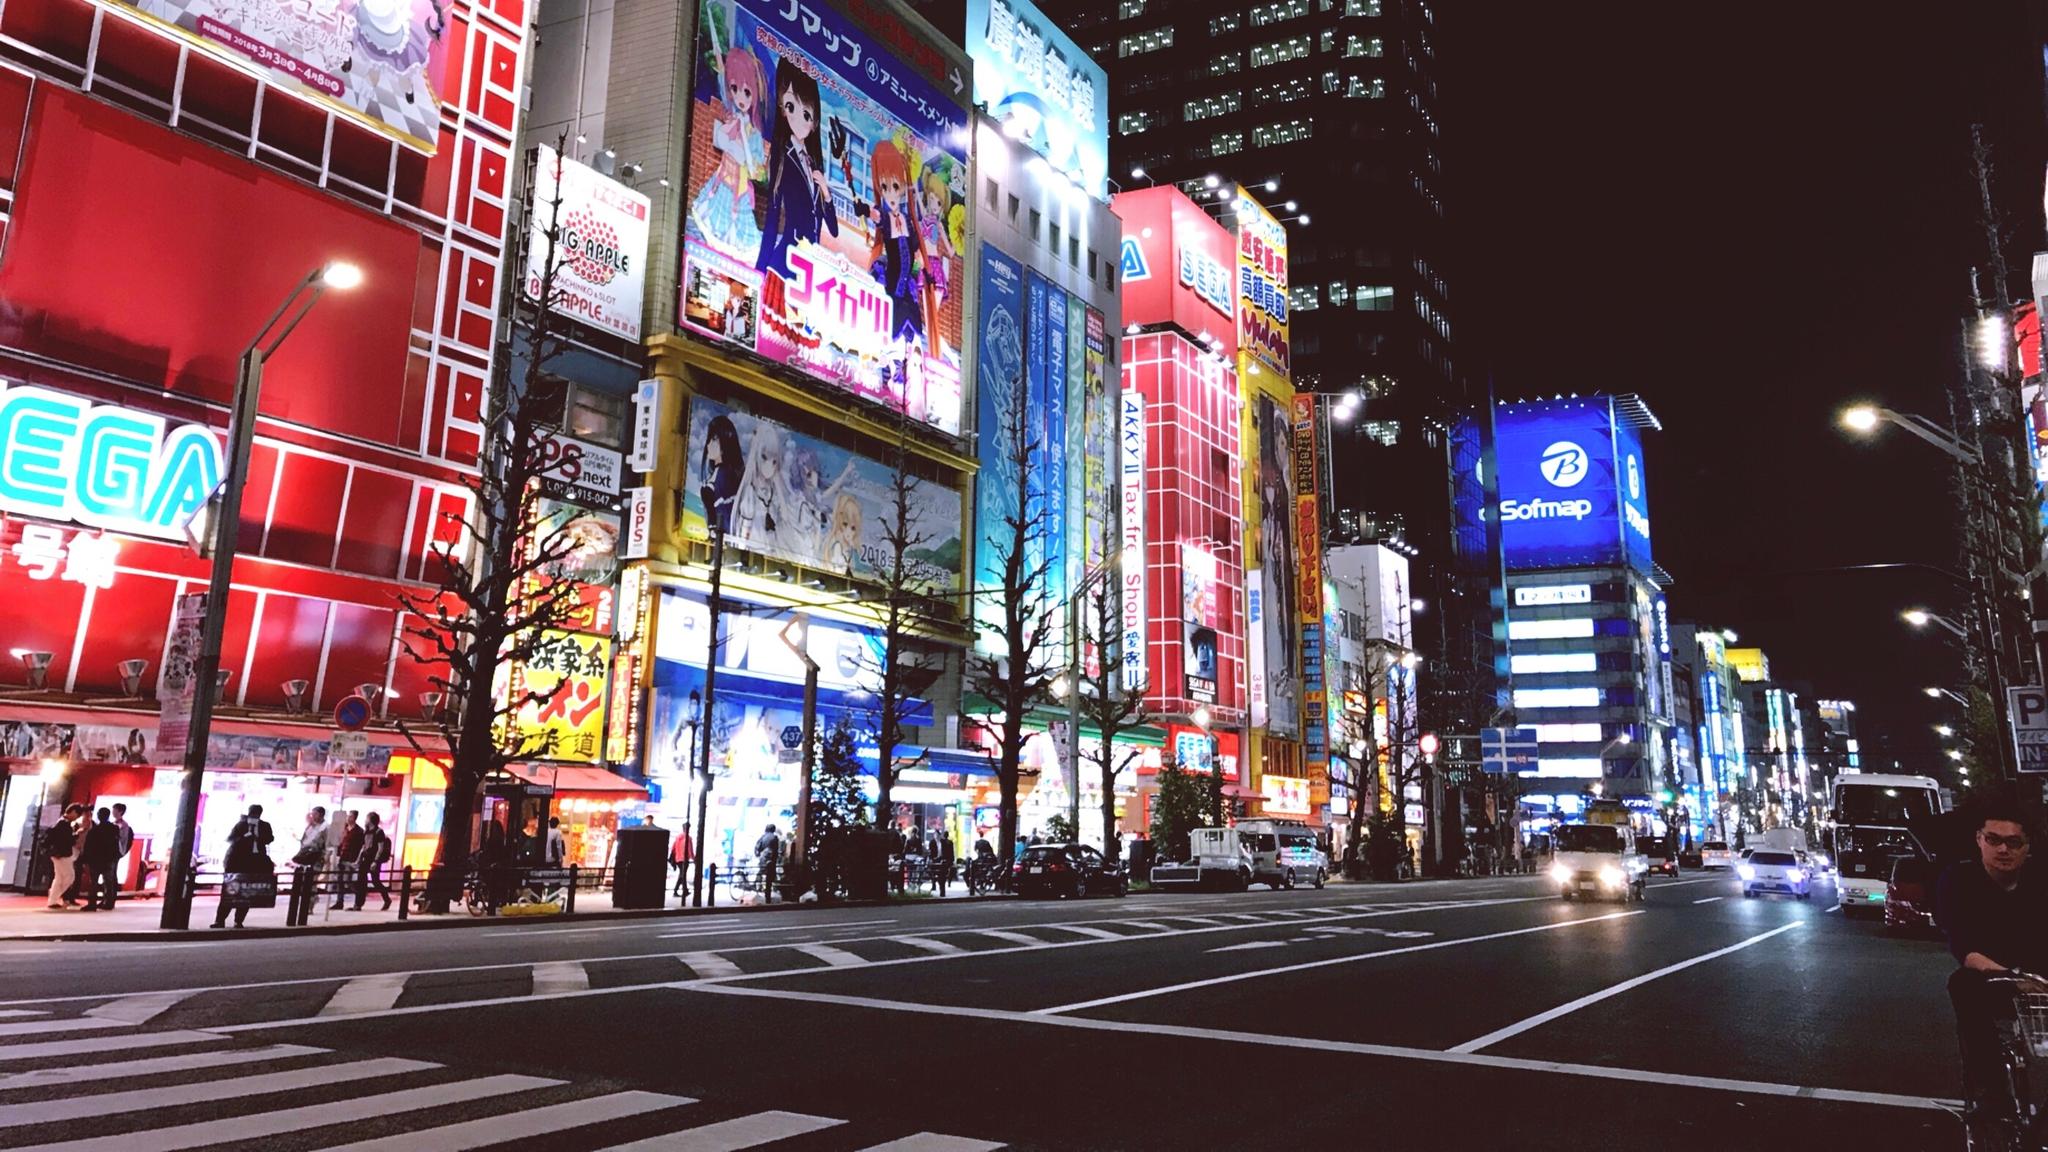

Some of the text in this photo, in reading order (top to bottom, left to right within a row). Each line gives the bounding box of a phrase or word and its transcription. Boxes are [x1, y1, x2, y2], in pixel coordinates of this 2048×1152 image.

[765, 0, 862, 67] フマップ
[585, 239, 629, 272] APPLE
[1181, 249, 1232, 313] SEGA
[1125, 400, 1140, 460] AKKY
[524, 428, 583, 479] PS
[583, 471, 611, 488] next
[634, 501, 647, 543] GPS
[1125, 480, 1142, 553] Tax-fr
[1500, 498, 1592, 521] Sofmap
[2017, 693, 2045, 725] P
[783, 732, 801, 741] 437
[2020, 745, 2041, 761] IN
